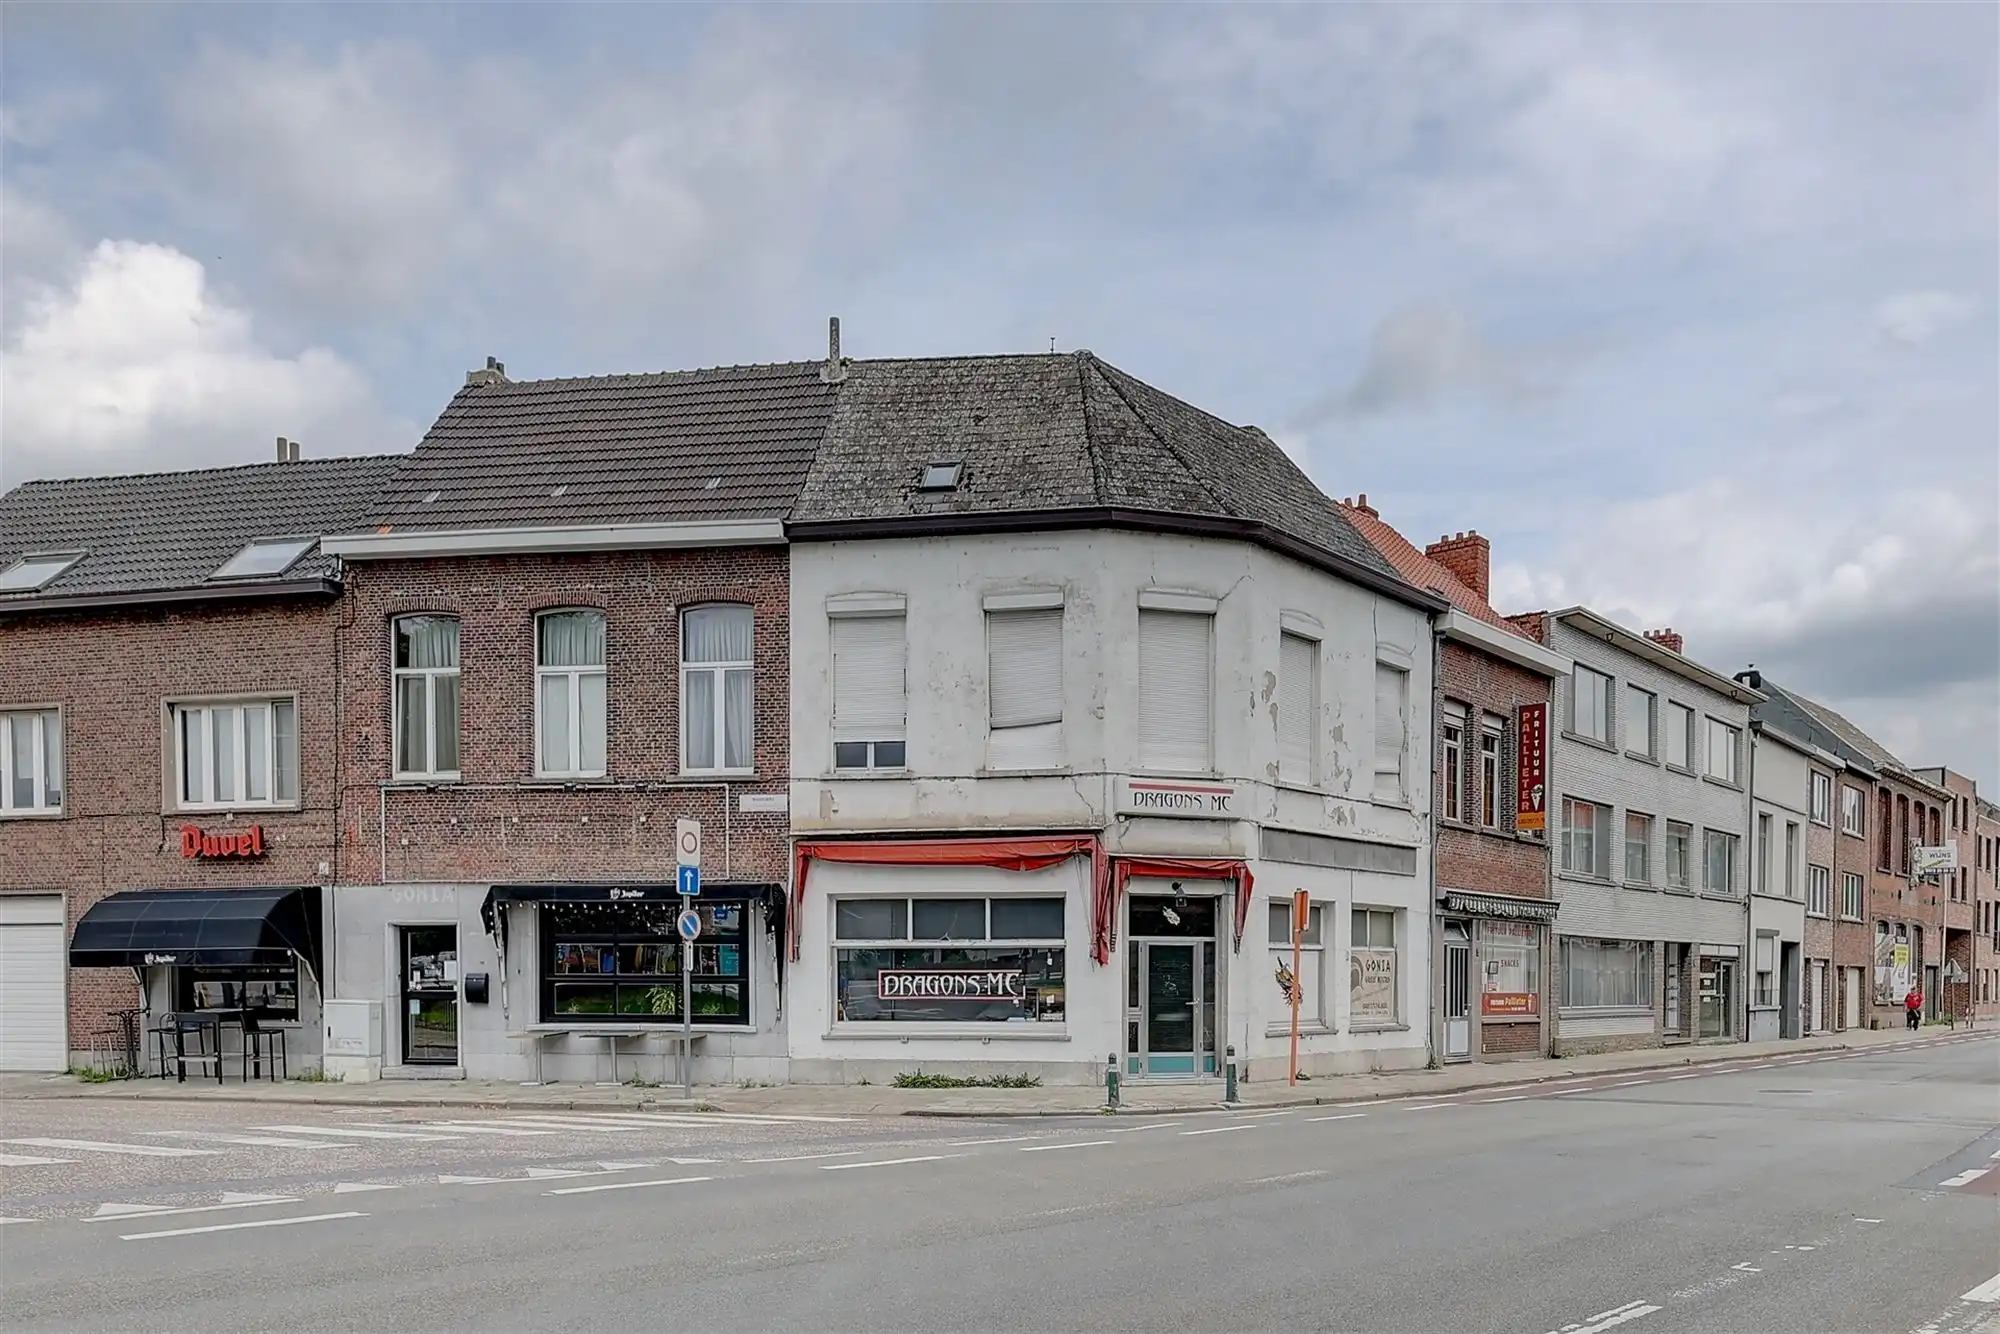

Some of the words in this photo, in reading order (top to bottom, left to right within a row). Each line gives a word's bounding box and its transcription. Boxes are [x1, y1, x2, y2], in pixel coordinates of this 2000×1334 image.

[1522, 712, 1530, 811] PALLIETER
[1134, 791, 1203, 809] DRAGONS
[1211, 795, 1231, 811] MC
[179, 823, 262, 857] Duvel
[884, 975, 980, 996] DRAGONS
[987, 973, 1019, 996] MC
